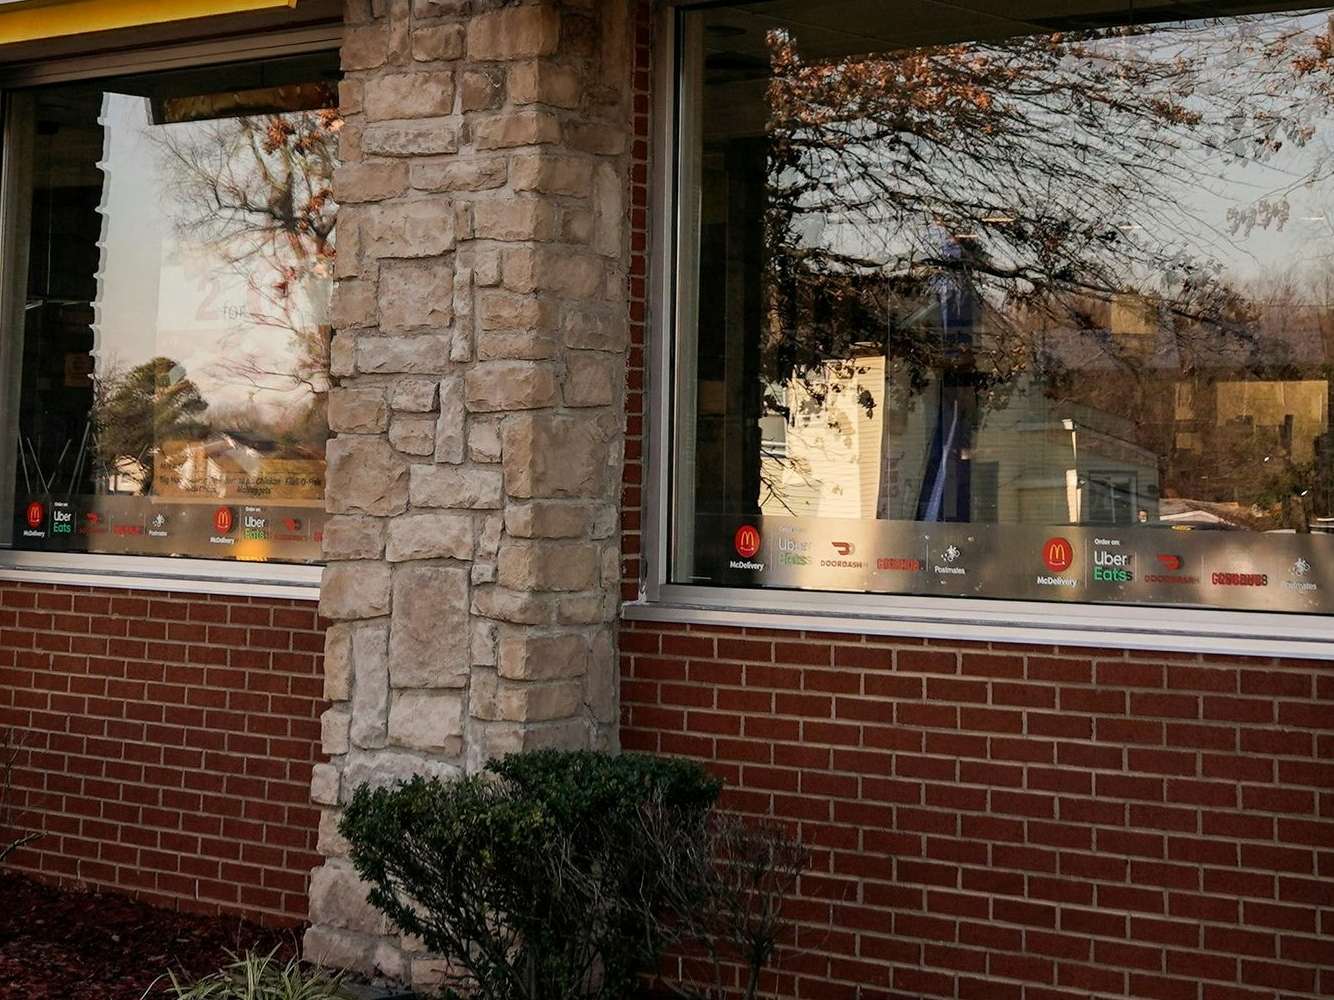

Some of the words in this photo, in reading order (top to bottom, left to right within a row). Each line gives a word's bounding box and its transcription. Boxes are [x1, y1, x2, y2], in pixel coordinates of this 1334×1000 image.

[53, 511, 71, 521] Uber
[53, 522, 71, 532] Eats
[245, 516, 266, 528] Uber
[244, 529, 265, 540] Eats
[1093, 538, 1110, 546] Order
[1094, 551, 1128, 566] Uber
[730, 561, 764, 571] McDelivery
[820, 560, 863, 568] DOORDASH
[934, 566, 965, 574] Postmates
[1094, 567, 1129, 581] Eats
[1037, 577, 1077, 587] McDelivery
